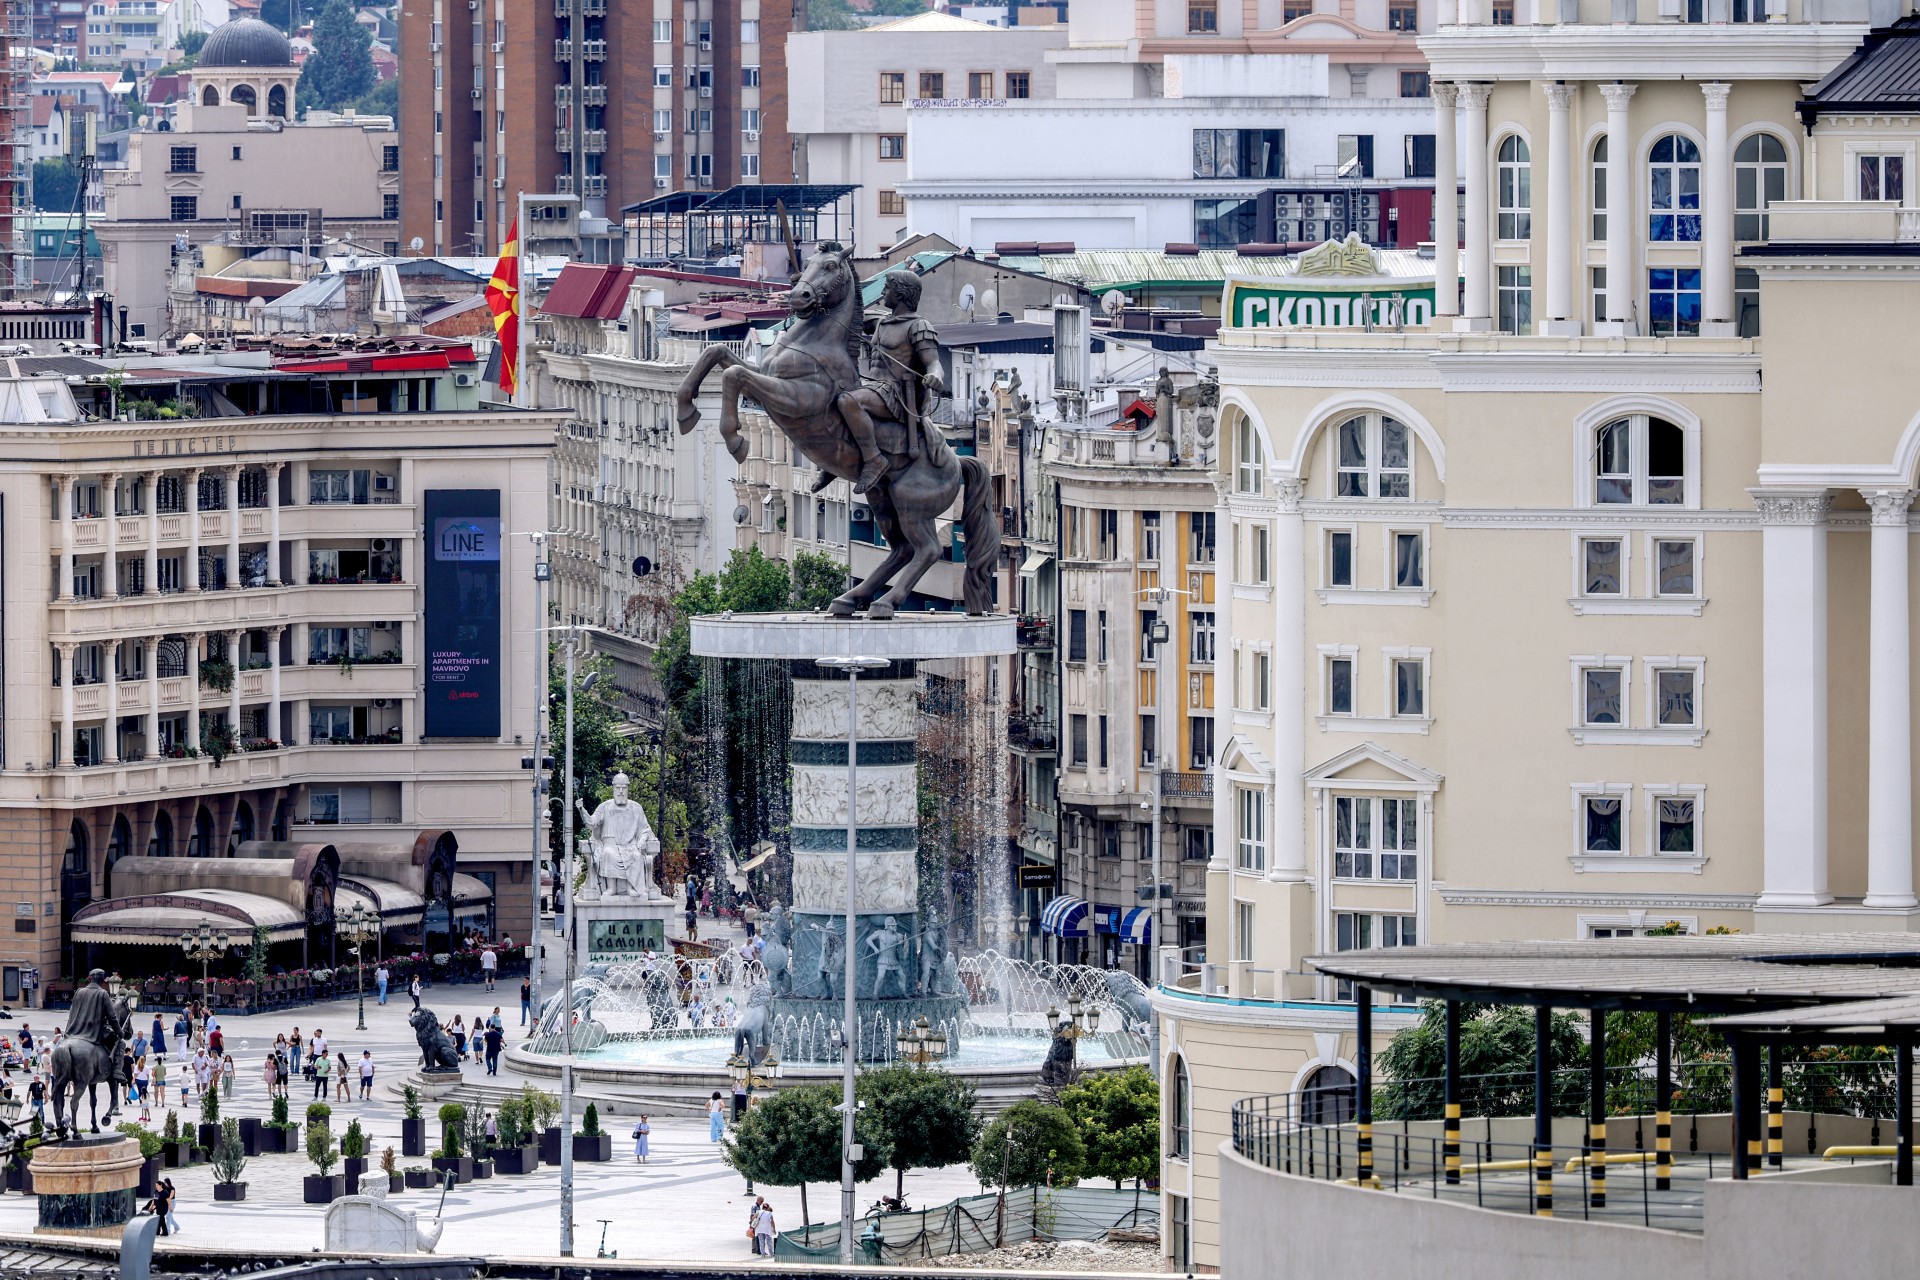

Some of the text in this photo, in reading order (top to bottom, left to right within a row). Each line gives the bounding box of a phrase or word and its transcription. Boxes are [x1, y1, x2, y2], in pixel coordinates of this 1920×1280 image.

[1242, 296, 1432, 328] СКОПСКО
[133, 435, 236, 456] ПЕЛИСТЕР
[442, 533, 485, 552] LINE
[608, 924, 643, 936] ЦАР
